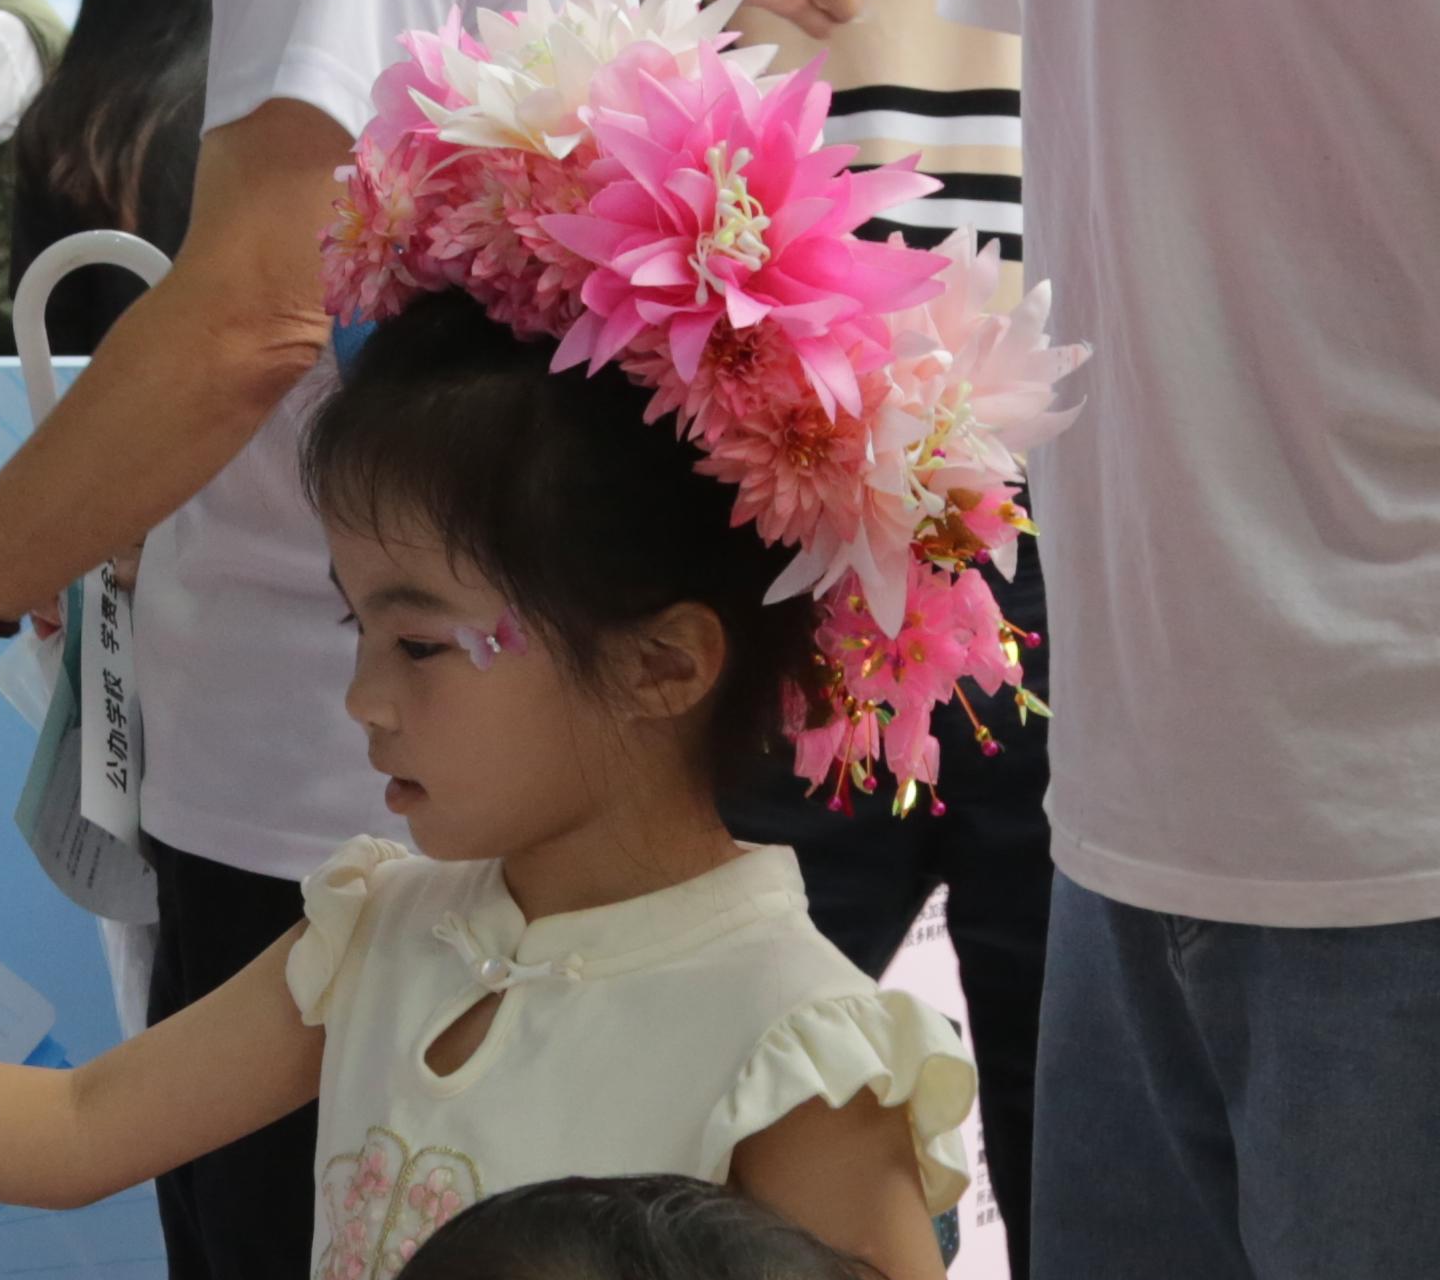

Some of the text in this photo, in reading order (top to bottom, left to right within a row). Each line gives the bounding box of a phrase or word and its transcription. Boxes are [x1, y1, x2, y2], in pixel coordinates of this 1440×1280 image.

[100, 552, 128, 794] 公办学校 学费全
